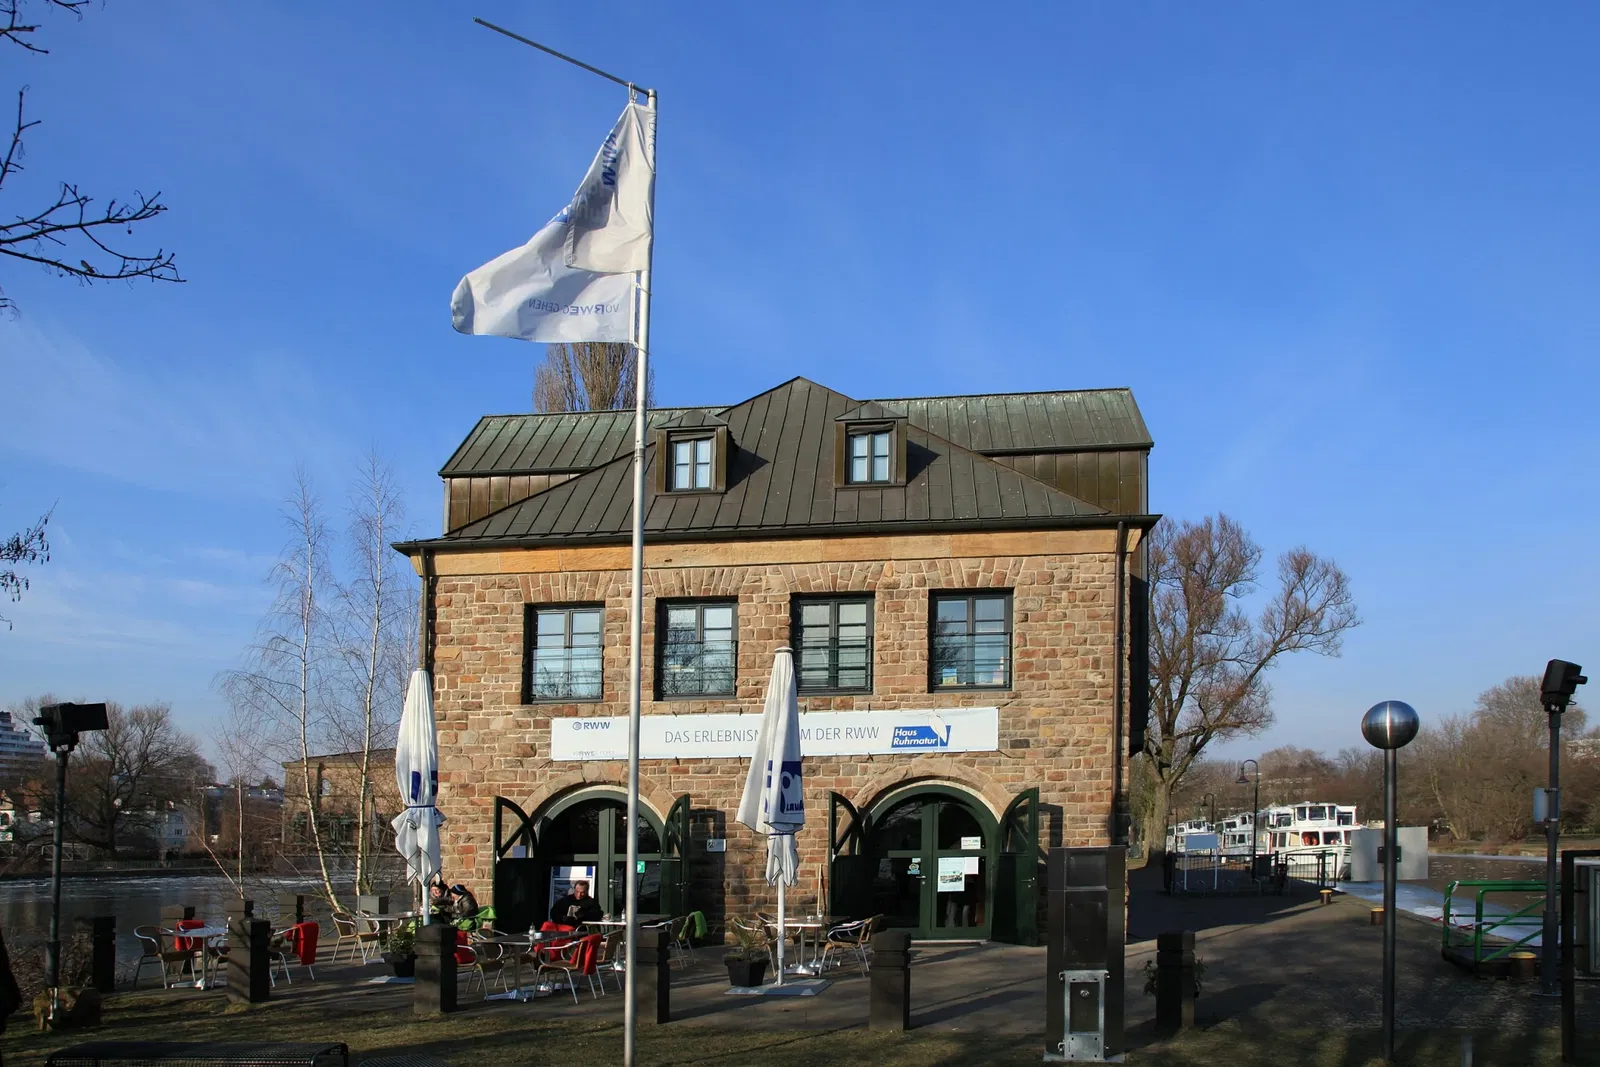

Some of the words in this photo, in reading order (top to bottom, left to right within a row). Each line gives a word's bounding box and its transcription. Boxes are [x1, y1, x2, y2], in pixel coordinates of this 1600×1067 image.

[583, 721, 611, 730] RWW
[665, 731, 690, 743] DAS
[816, 727, 841, 740] DER
[845, 726, 880, 739] RWW
[894, 728, 918, 737] Haus
[893, 736, 938, 746] Ruhrnatur
